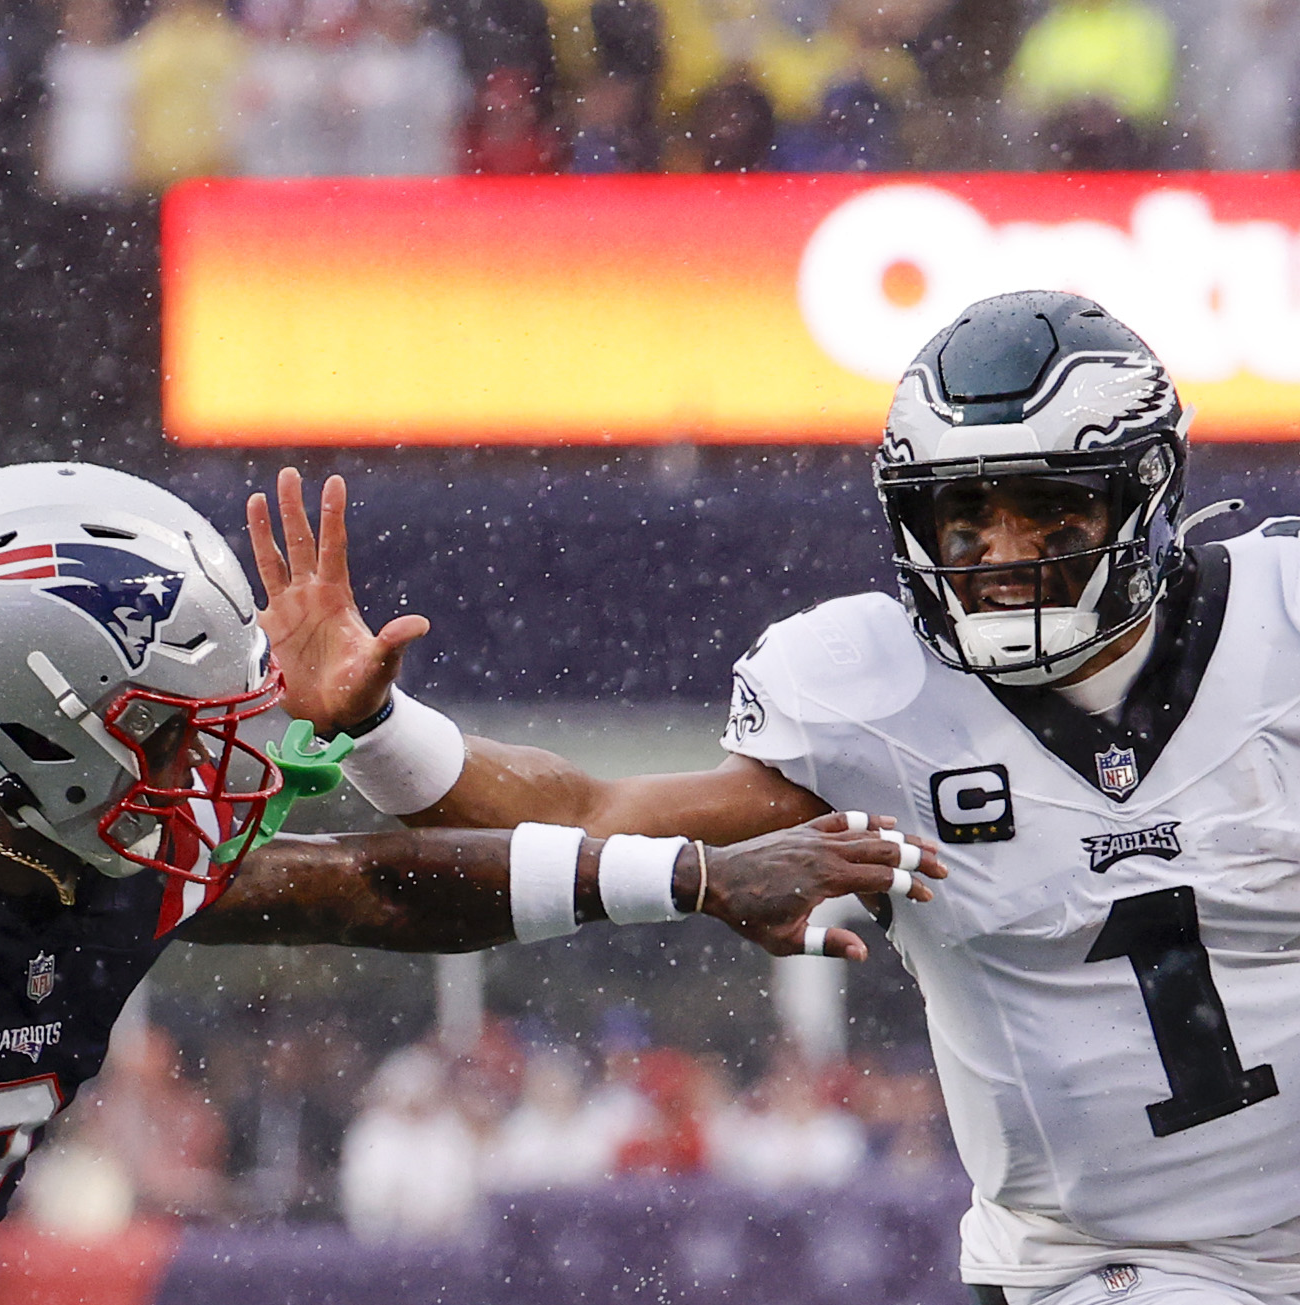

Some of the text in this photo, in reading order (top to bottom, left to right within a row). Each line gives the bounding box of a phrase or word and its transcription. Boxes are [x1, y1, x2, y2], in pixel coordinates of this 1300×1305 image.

[1106, 768, 1133, 787] NFL
[938, 771, 1006, 825] C
[1084, 823, 1180, 869] EAGLES
[32, 974, 49, 994] NFL
[1085, 886, 1279, 1138] 1
[1107, 1271, 1135, 1289] NFL
